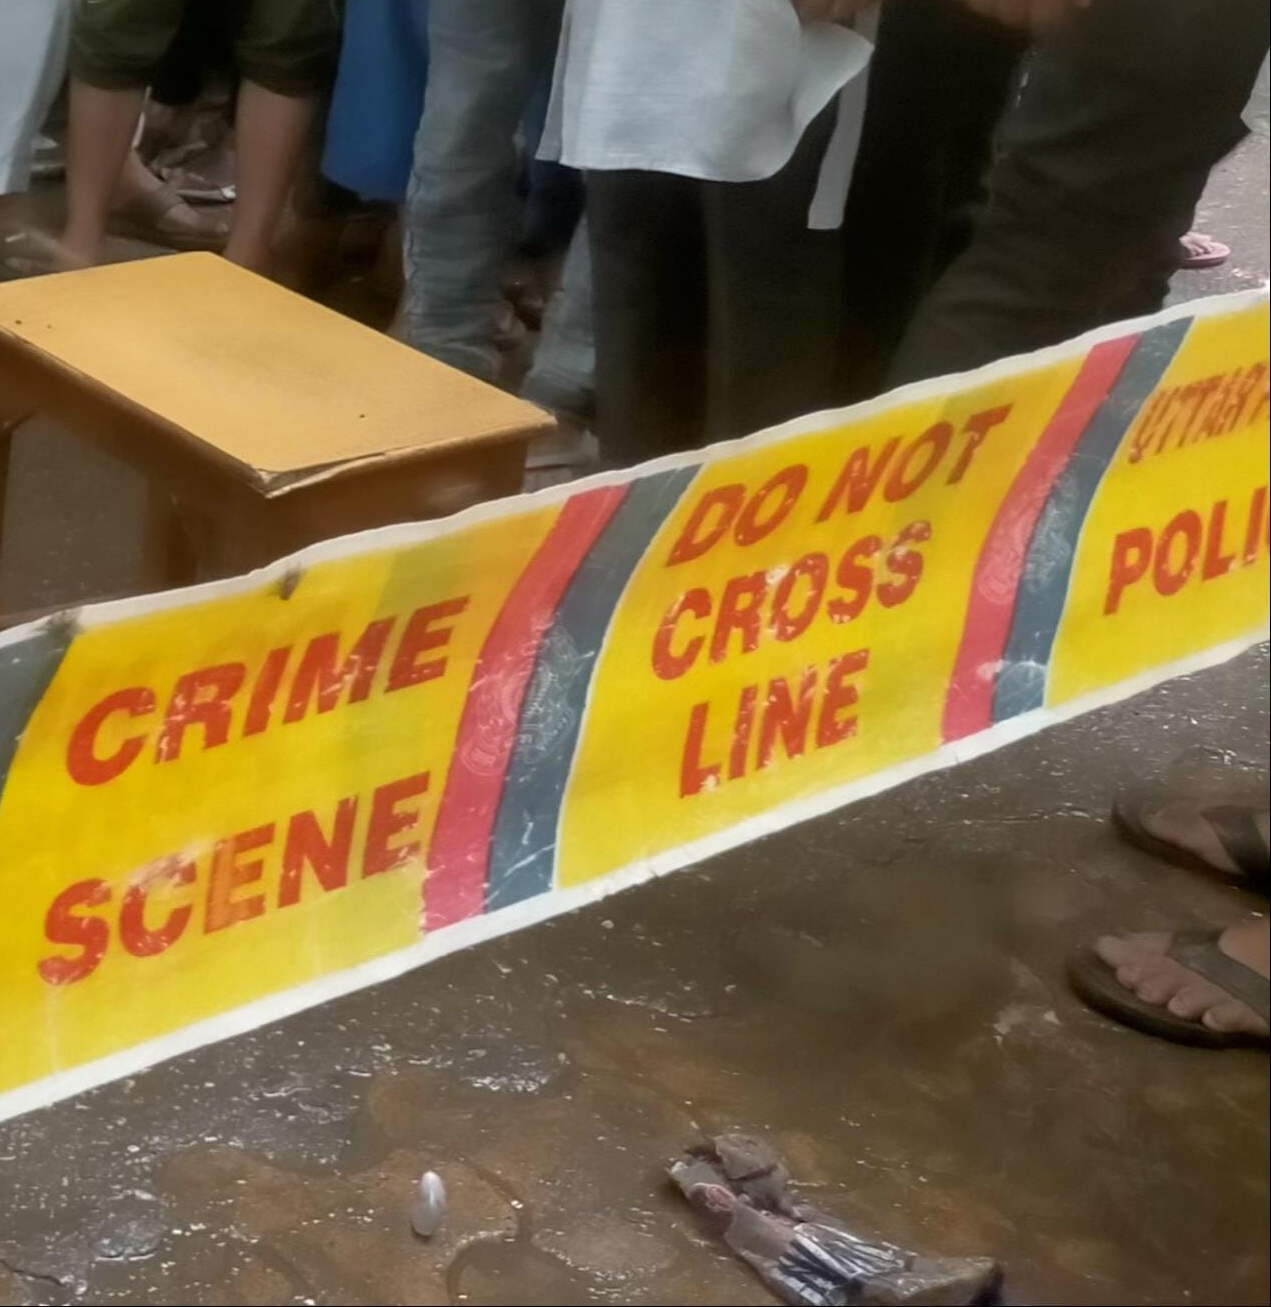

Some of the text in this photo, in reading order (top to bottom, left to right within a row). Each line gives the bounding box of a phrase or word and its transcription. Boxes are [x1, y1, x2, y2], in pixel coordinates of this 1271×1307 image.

[665, 402, 1014, 568] DO NOT
[1102, 484, 1269, 617] POLI
[650, 520, 932, 681] CROSS
[66, 595, 470, 786] CRIME
[679, 649, 869, 799] LINE
[37, 770, 431, 987] SCENE
